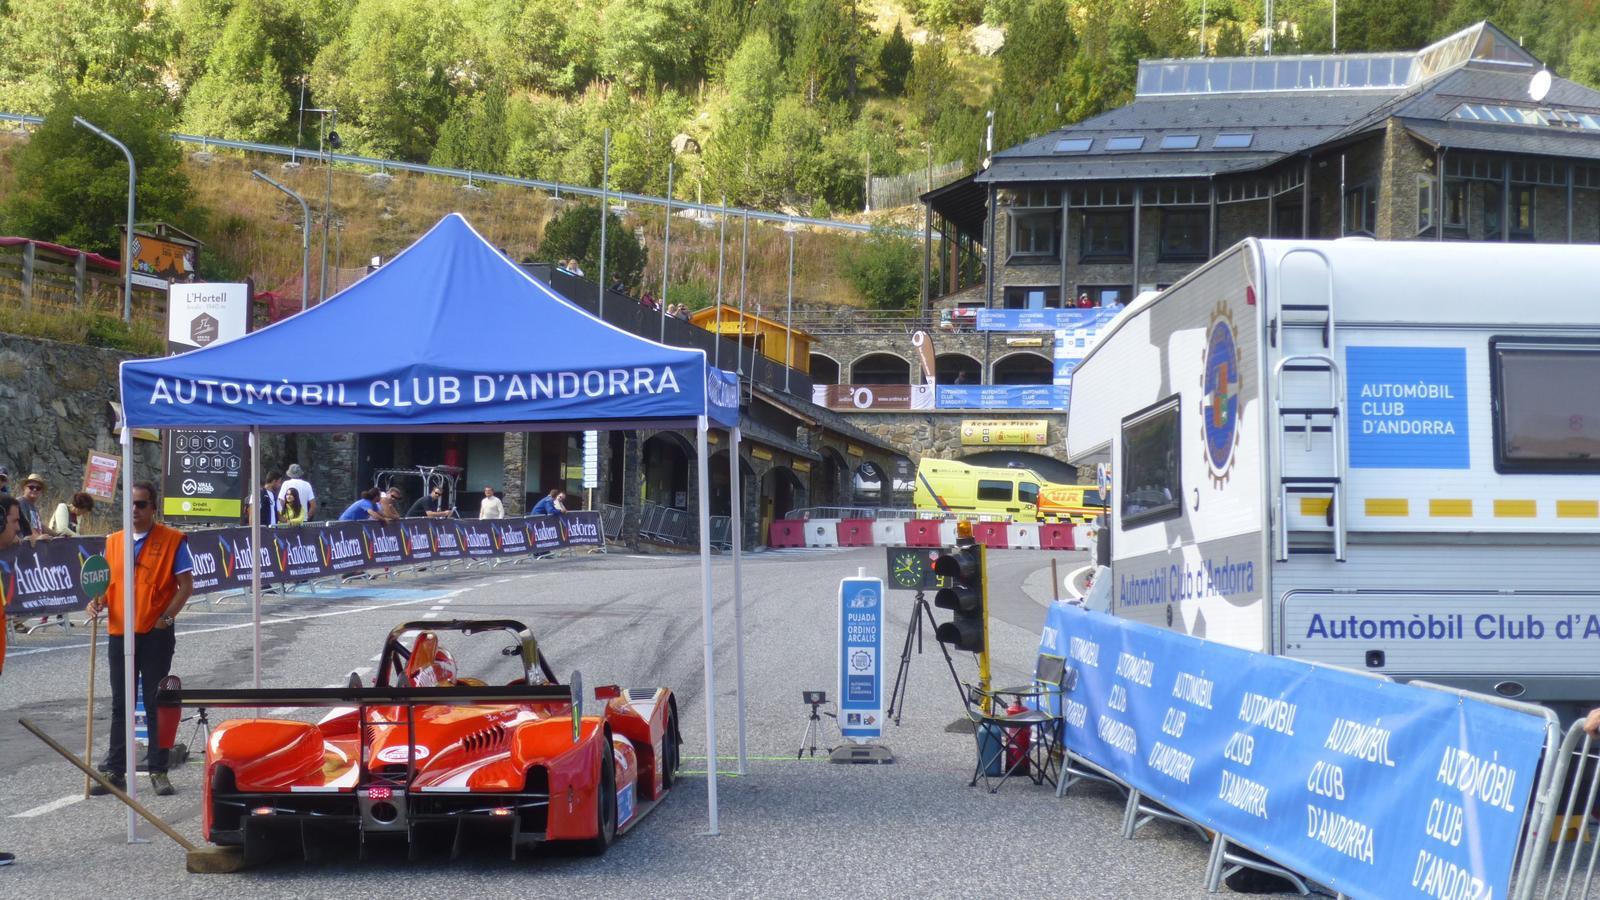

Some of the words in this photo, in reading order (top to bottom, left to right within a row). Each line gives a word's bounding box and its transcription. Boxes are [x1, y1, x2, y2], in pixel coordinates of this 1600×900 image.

[186, 291, 227, 303] L'Hortell
[149, 378, 357, 406] AUTOMÒBIL
[368, 376, 461, 407] CLUB
[473, 365, 681, 404] D'ANDORRA
[1361, 380, 1455, 399] AUTOMÒBIL
[1362, 402, 1405, 416] CLUB
[1363, 420, 1455, 435] D'ANDORRA
[330, 531, 362, 560] Andorra
[533, 521, 558, 541] Andorra
[286, 534, 318, 565] Andorra
[14, 551, 73, 595] Andorra
[82, 568, 110, 585] START
[1120, 567, 1166, 607] Automòbil
[1170, 562, 1193, 600] Club
[1196, 556, 1254, 598] d'Andorra
[848, 613, 876, 622] PUJADA
[848, 625, 877, 634] ORDINO
[1306, 613, 1463, 640] Automòbil
[1474, 613, 1545, 640] Club
[1108, 683, 1126, 713] CLUB
[1162, 707, 1187, 738] CLUB
[1148, 741, 1196, 784] D'ANDORRA
[1224, 731, 1255, 766] CLUB
[1218, 769, 1269, 820] D'ANDORRA
[1307, 760, 1345, 801] CLUB
[1307, 804, 1374, 865] D'ANDORRA
[1426, 797, 1463, 847] CLUB
